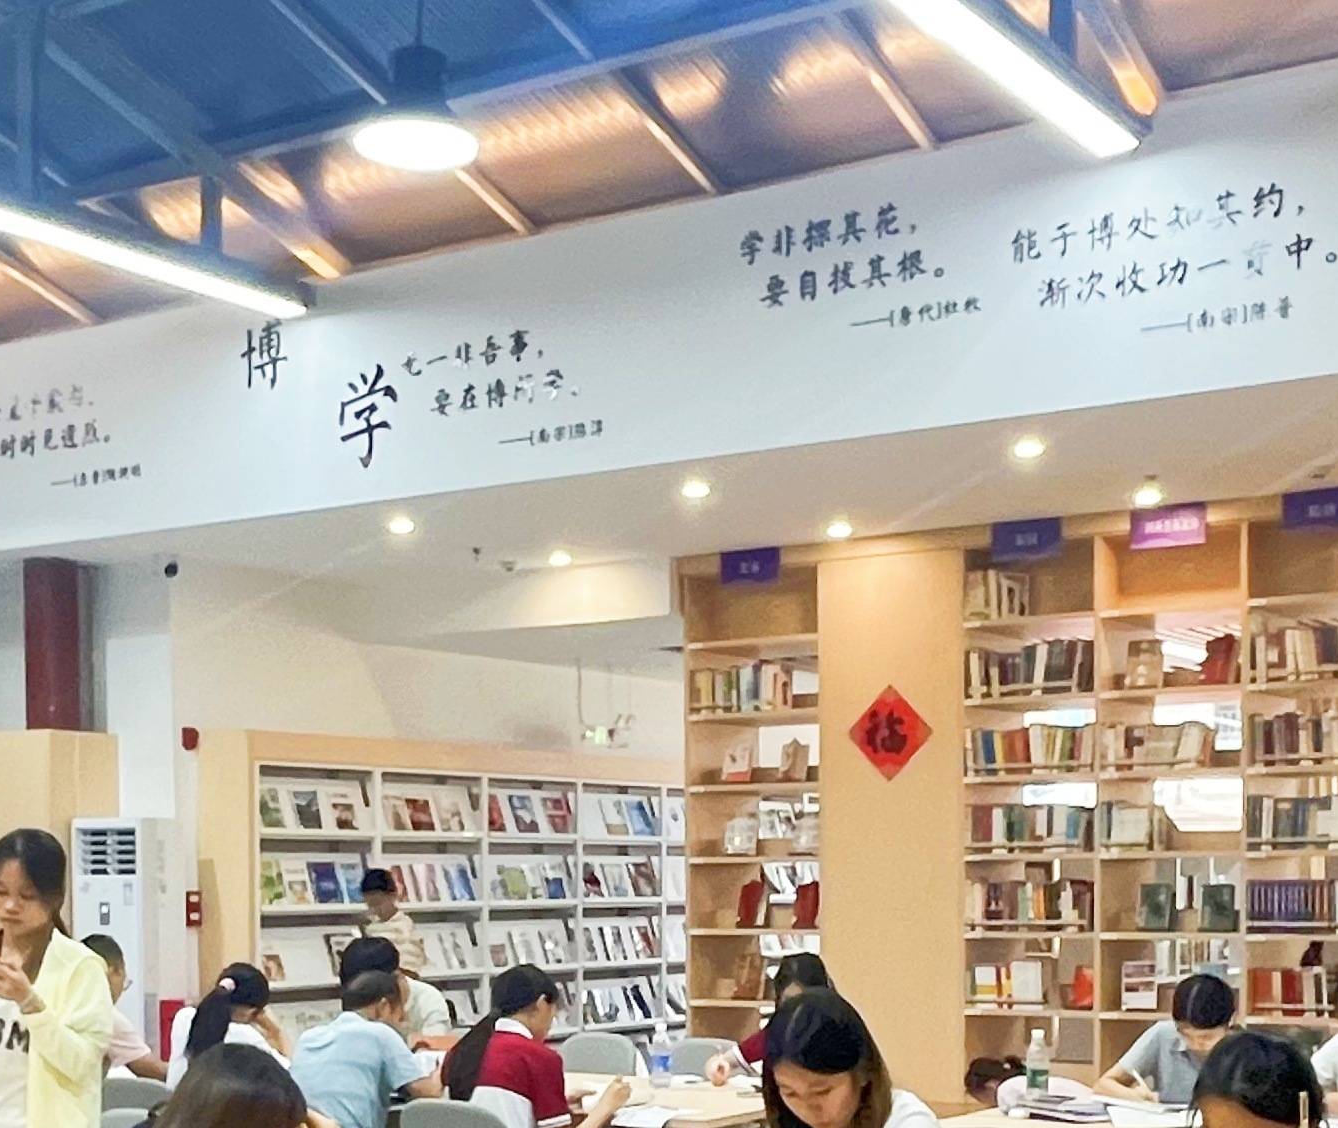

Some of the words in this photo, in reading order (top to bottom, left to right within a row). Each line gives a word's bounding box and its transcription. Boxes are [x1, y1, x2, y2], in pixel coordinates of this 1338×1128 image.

[740, 202, 916, 265] 学非探其花，
[1012, 182, 1304, 263] 能于博处知其约，
[760, 250, 944, 308] 要自拔其根。
[338, 363, 398, 469] 学
[865, 709, 908, 755] 福
